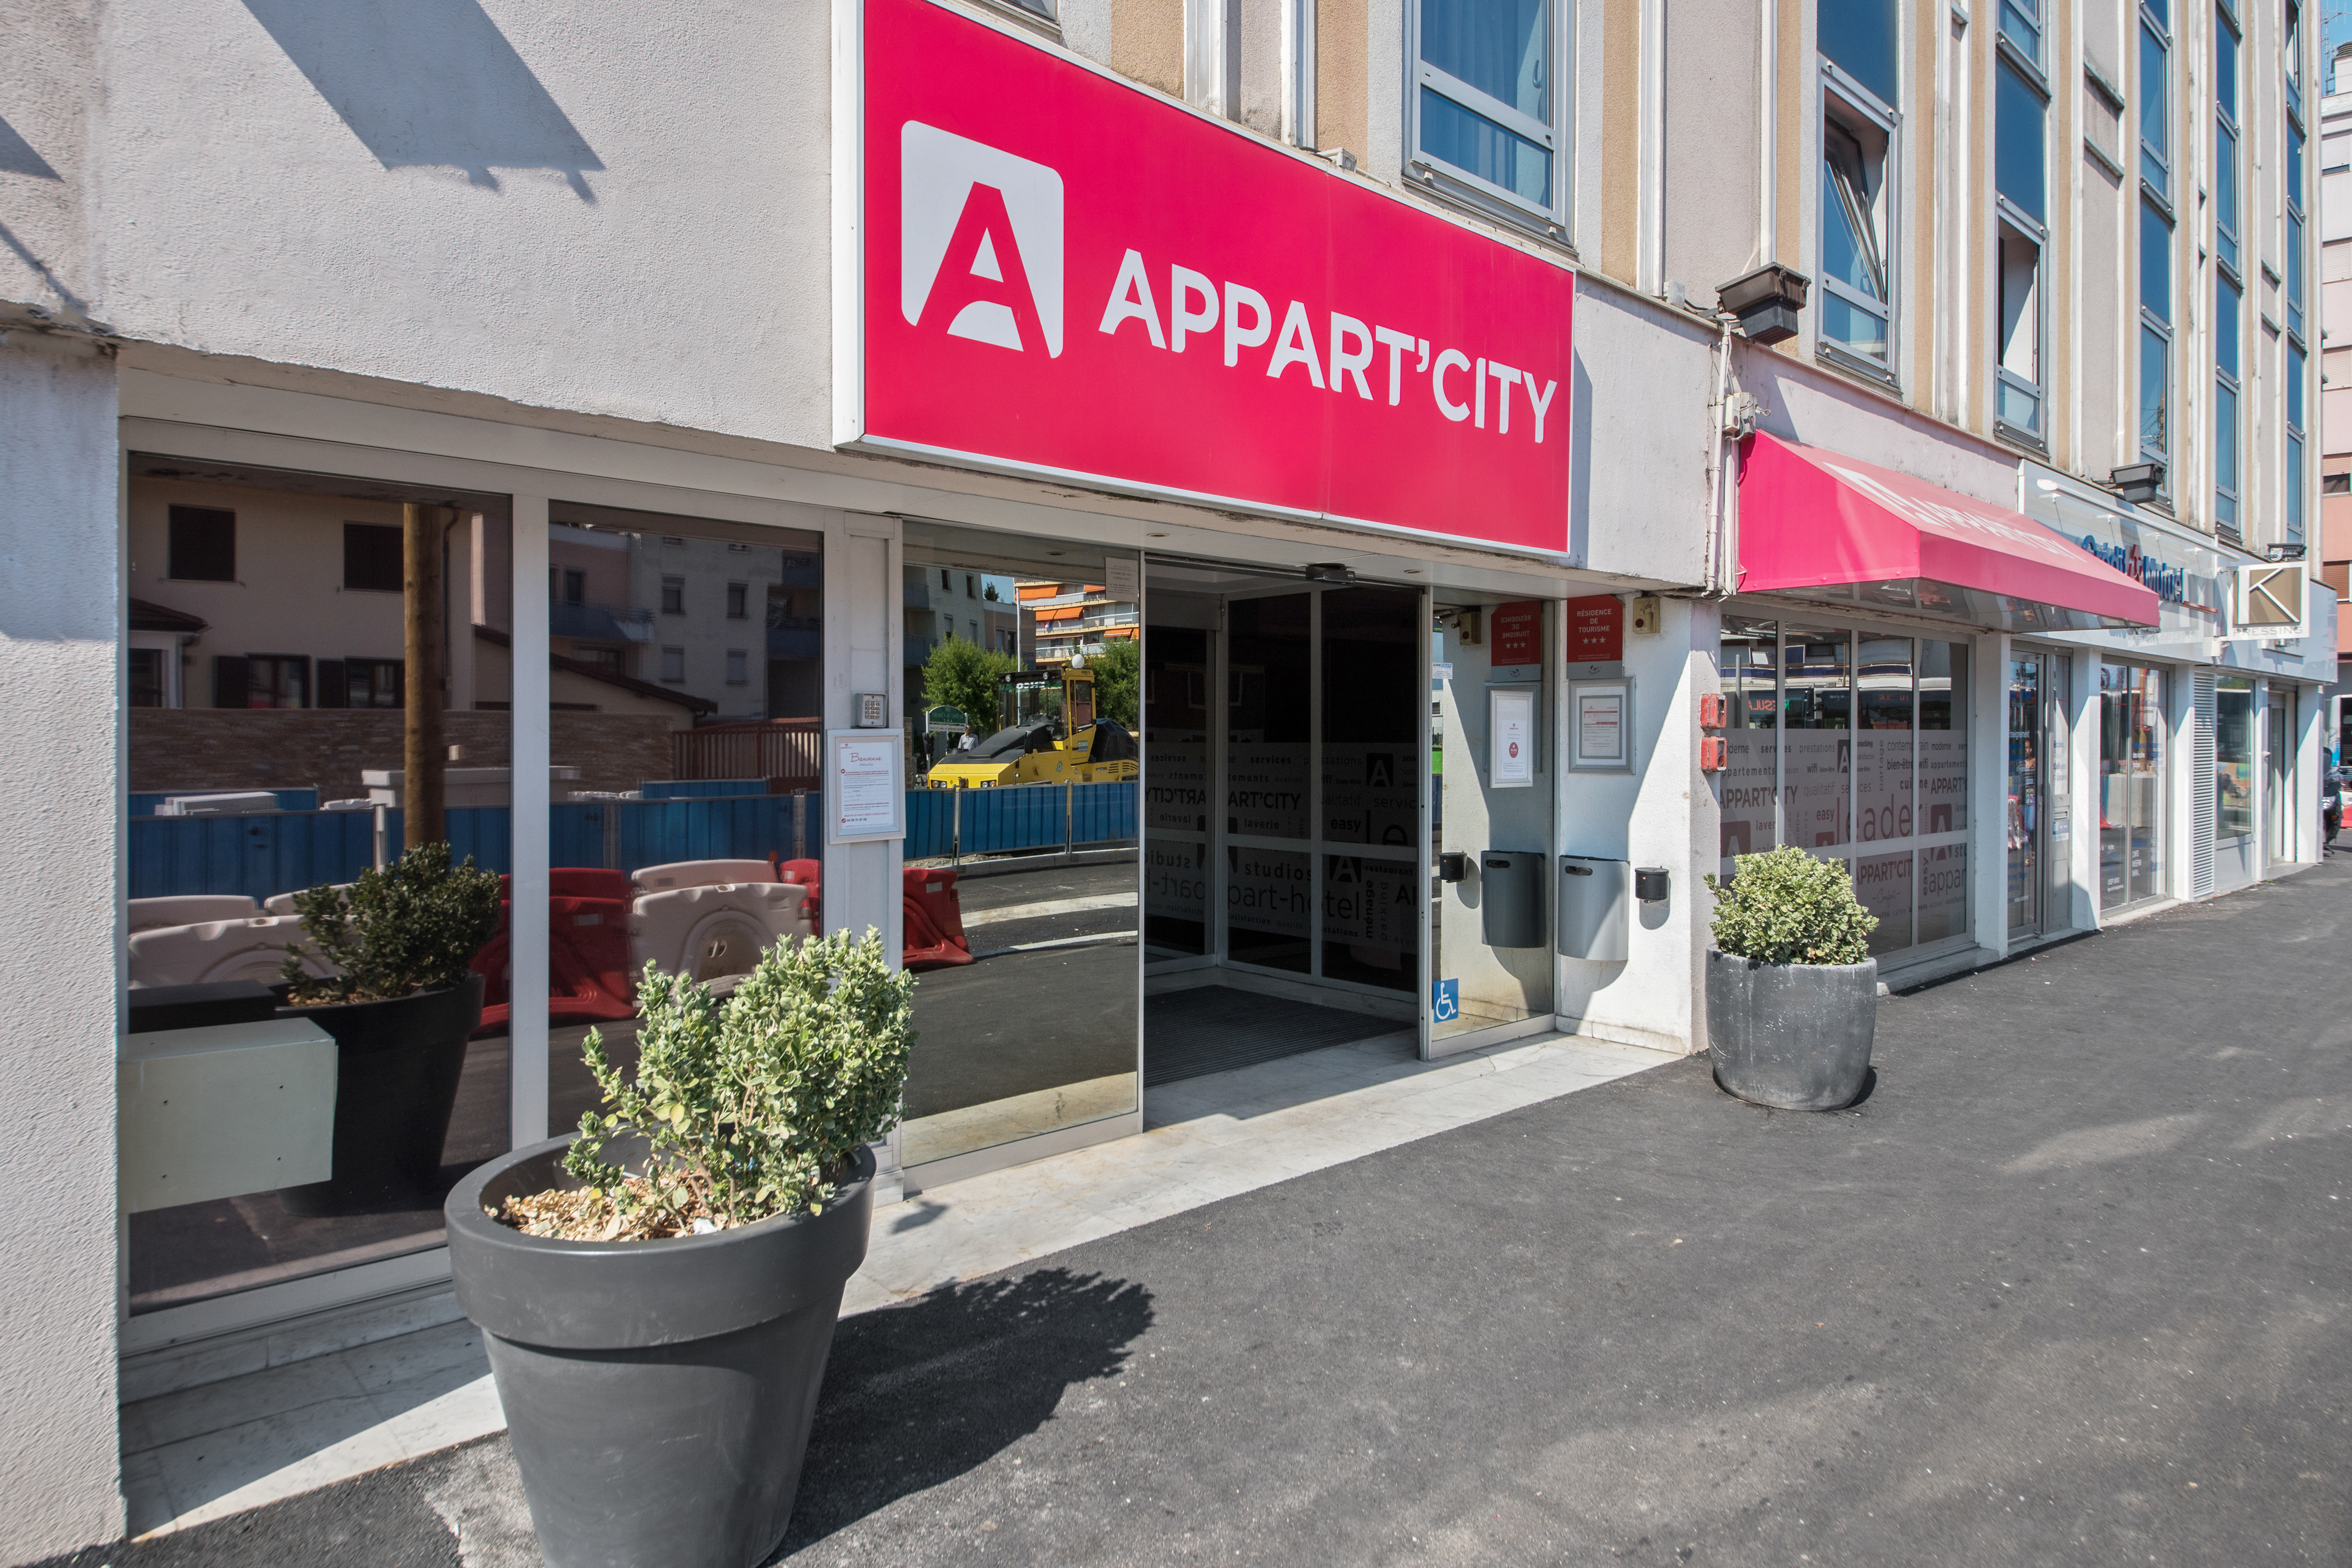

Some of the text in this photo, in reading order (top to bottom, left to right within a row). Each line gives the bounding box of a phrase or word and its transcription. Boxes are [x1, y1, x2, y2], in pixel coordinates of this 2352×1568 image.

[1098, 249, 1558, 444] APPART'CITY
[2143, 556, 2184, 603] Mutuel
[2238, 567, 2301, 624] K
[1576, 609, 1612, 617] RÉSIDENCE
[1578, 625, 1610, 633] TOURISME
[2233, 626, 2303, 636] PRESSING
[2009, 730, 2029, 739] nseignement
[1726, 743, 1836, 755] oderne serves prestations
[1931, 741, 1952, 750] moderne
[849, 752, 882, 762] Bienvenue
[1250, 755, 1291, 764] services
[1721, 766, 1776, 779] ppartements
[1807, 763, 1817, 773] wifi
[1900, 777, 1929, 790] cuine
[1720, 785, 1798, 810] APPART'CTY
[1816, 809, 1835, 822] easy
[1837, 794, 1923, 845] lade
[1244, 818, 1280, 830] laverie
[1330, 818, 1361, 833] easy
[1365, 864, 1414, 876] restaurant
[1379, 882, 1389, 941] parking
